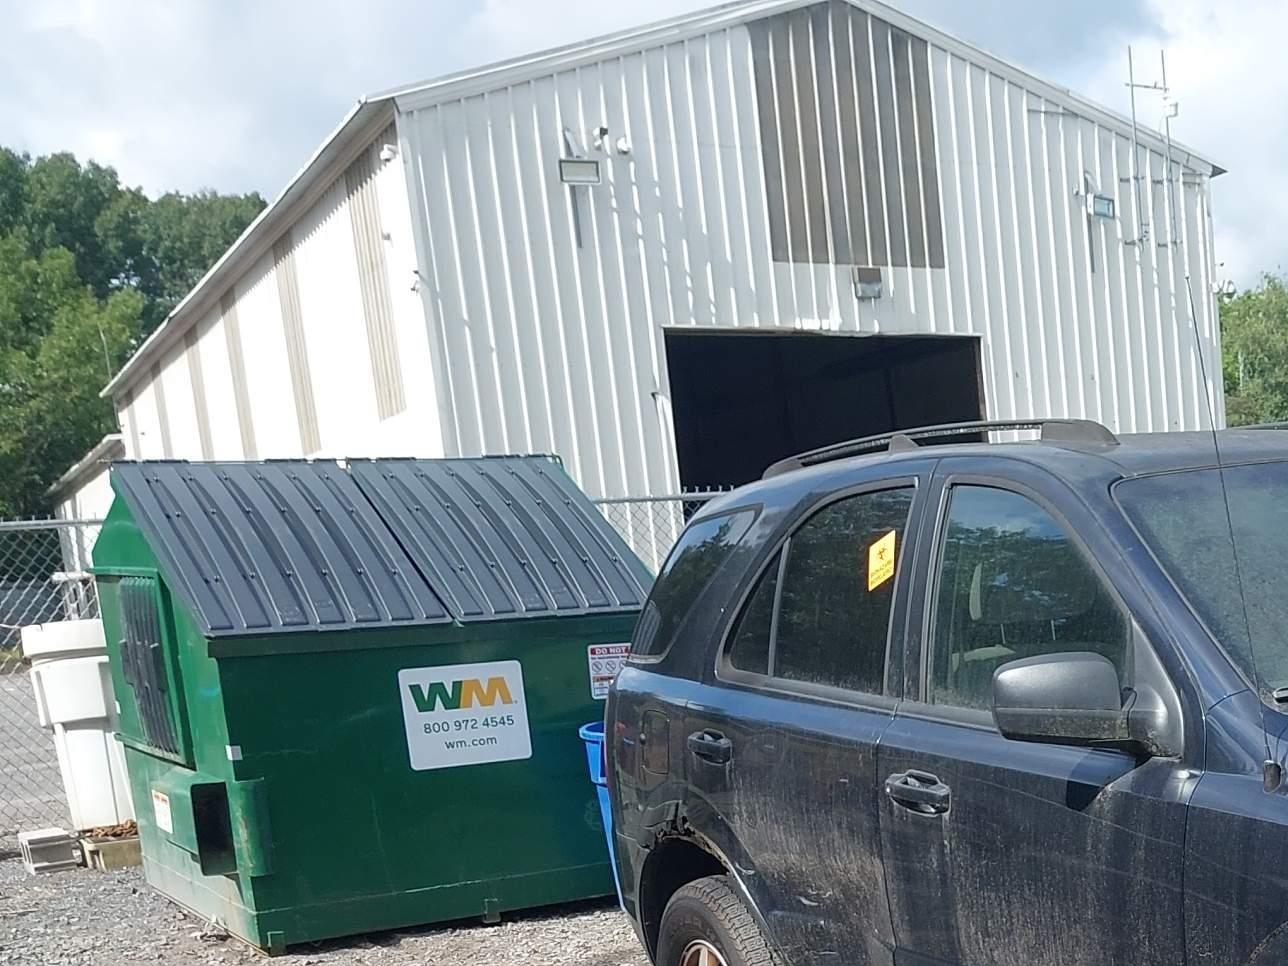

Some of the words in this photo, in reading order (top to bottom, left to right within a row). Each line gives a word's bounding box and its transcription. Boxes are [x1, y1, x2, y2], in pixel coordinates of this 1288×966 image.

[408, 676, 513, 713] WM
[424, 721, 450, 734] 800
[454, 718, 478, 731] 972
[482, 714, 514, 728] 4545
[444, 736, 497, 749] wm.com
